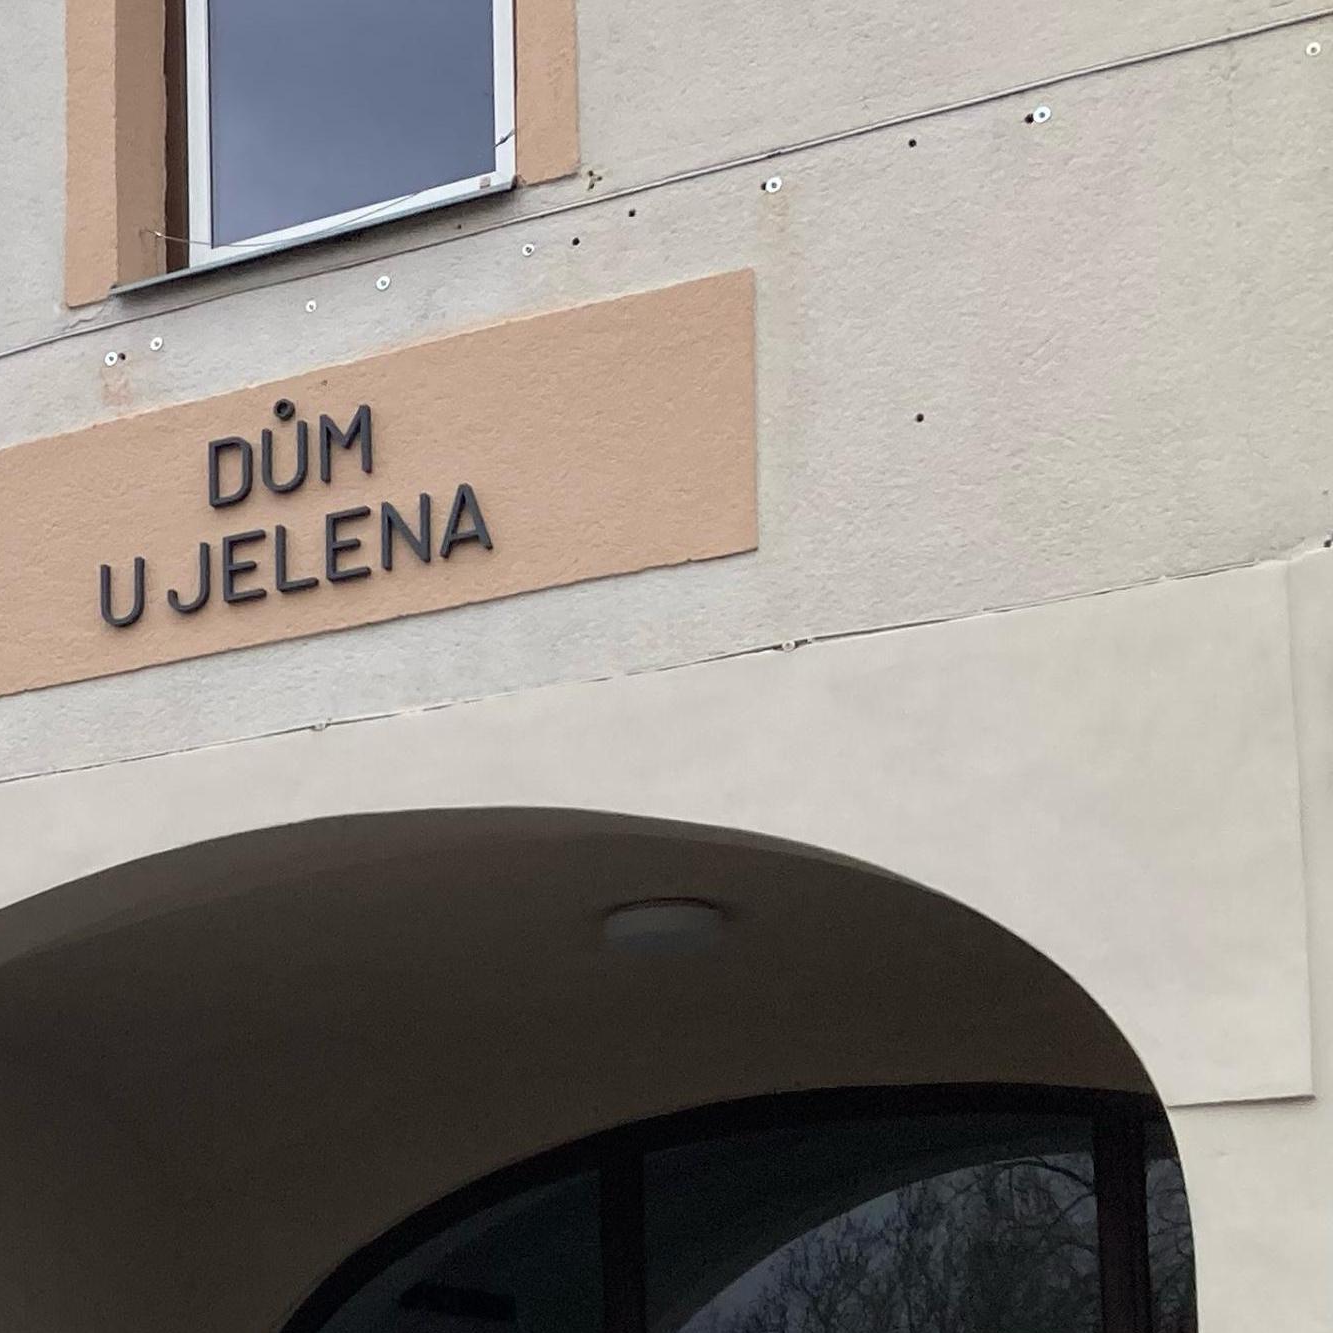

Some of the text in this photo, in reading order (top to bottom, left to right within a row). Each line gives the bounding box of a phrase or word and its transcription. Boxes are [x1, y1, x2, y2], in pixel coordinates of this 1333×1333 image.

[208, 398, 374, 509] DŮM
[100, 483, 495, 628] U JELENA
